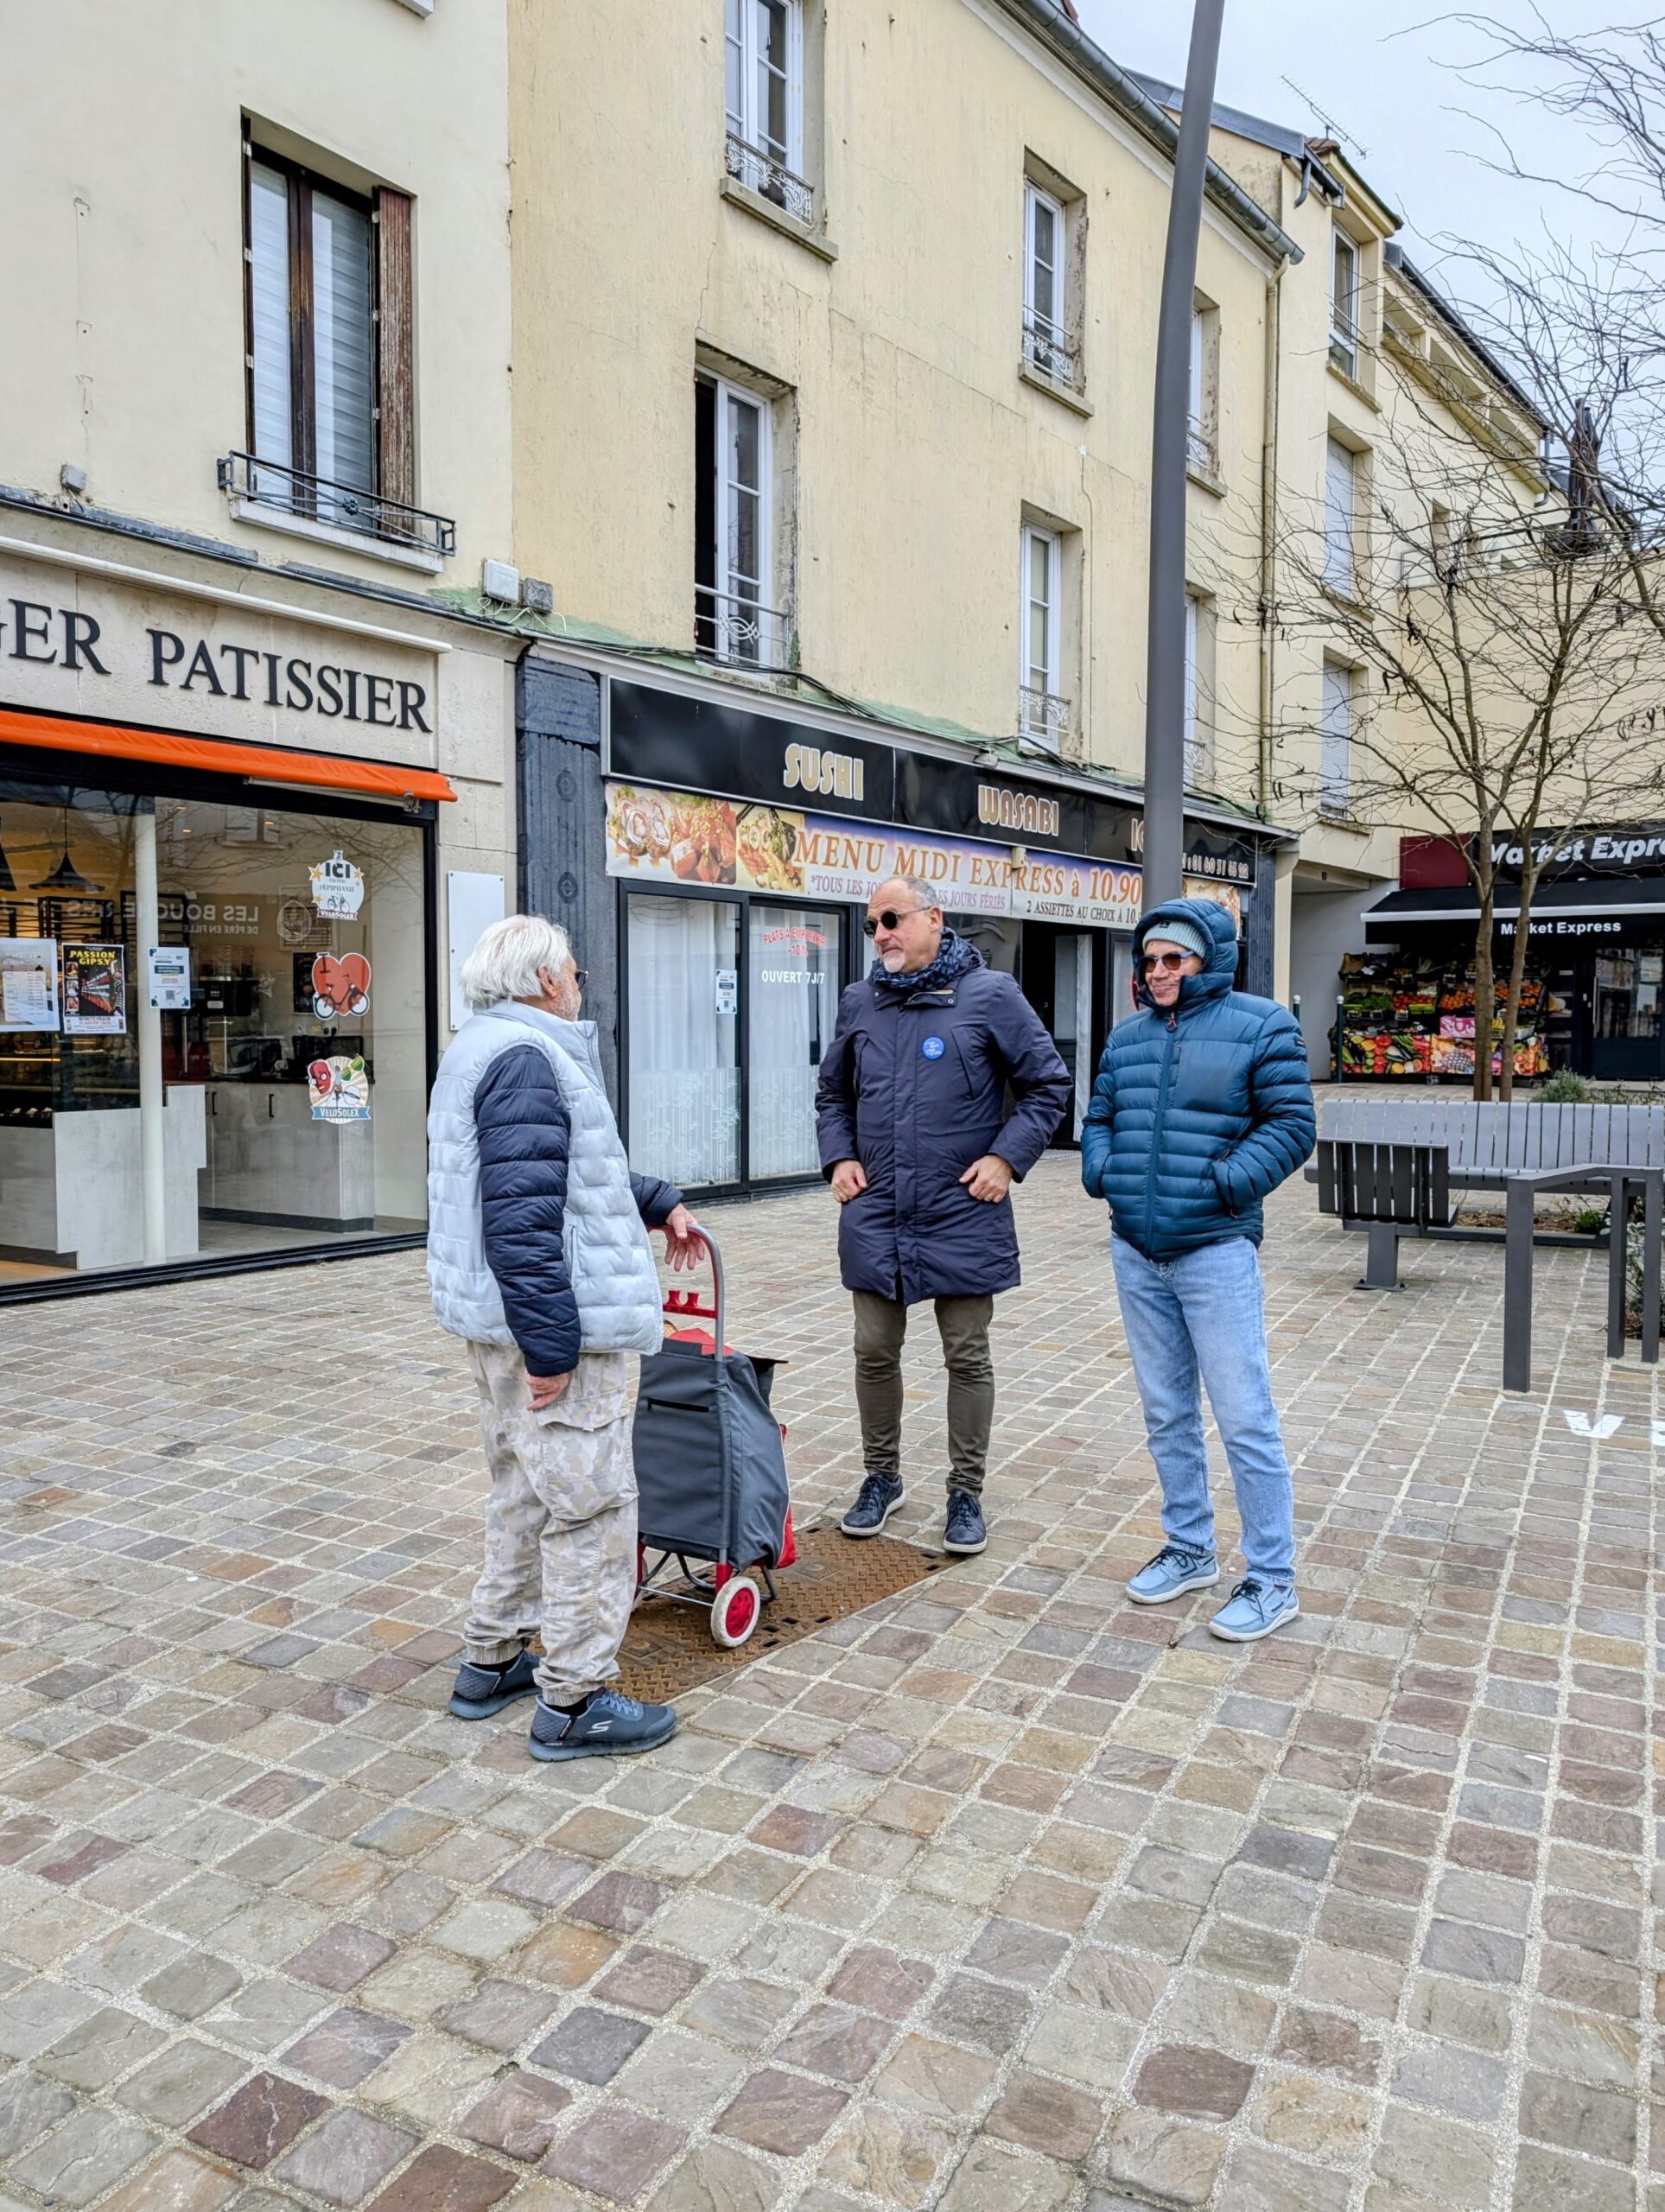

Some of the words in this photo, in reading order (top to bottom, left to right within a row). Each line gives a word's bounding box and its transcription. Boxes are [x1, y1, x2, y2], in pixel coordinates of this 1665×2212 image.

[0, 598, 111, 675] ER
[146, 628, 432, 733] PATISSIER
[783, 743, 864, 801] SUSHI
[978, 785, 1059, 836] WASABI
[325, 862, 351, 879] ICI
[793, 830, 886, 874] MENU
[893, 846, 961, 883] MIDI
[969, 856, 1065, 896] EXPRESS
[1071, 872, 1081, 898] à
[1089, 869, 1141, 905] 10.90
[846, 878, 862, 896] LES
[950, 891, 977, 908] JOURS
[1026, 899, 1032, 913] 2
[1034, 901, 1074, 918] ASSIETTES
[1077, 905, 1088, 919] AU
[1090, 907, 1115, 922] CHOIX
[1557, 921, 1622, 936] Express
[69, 950, 116, 959] PASSION
[761, 969, 803, 984] OUVERT
[805, 972, 825, 985] 7J/7
